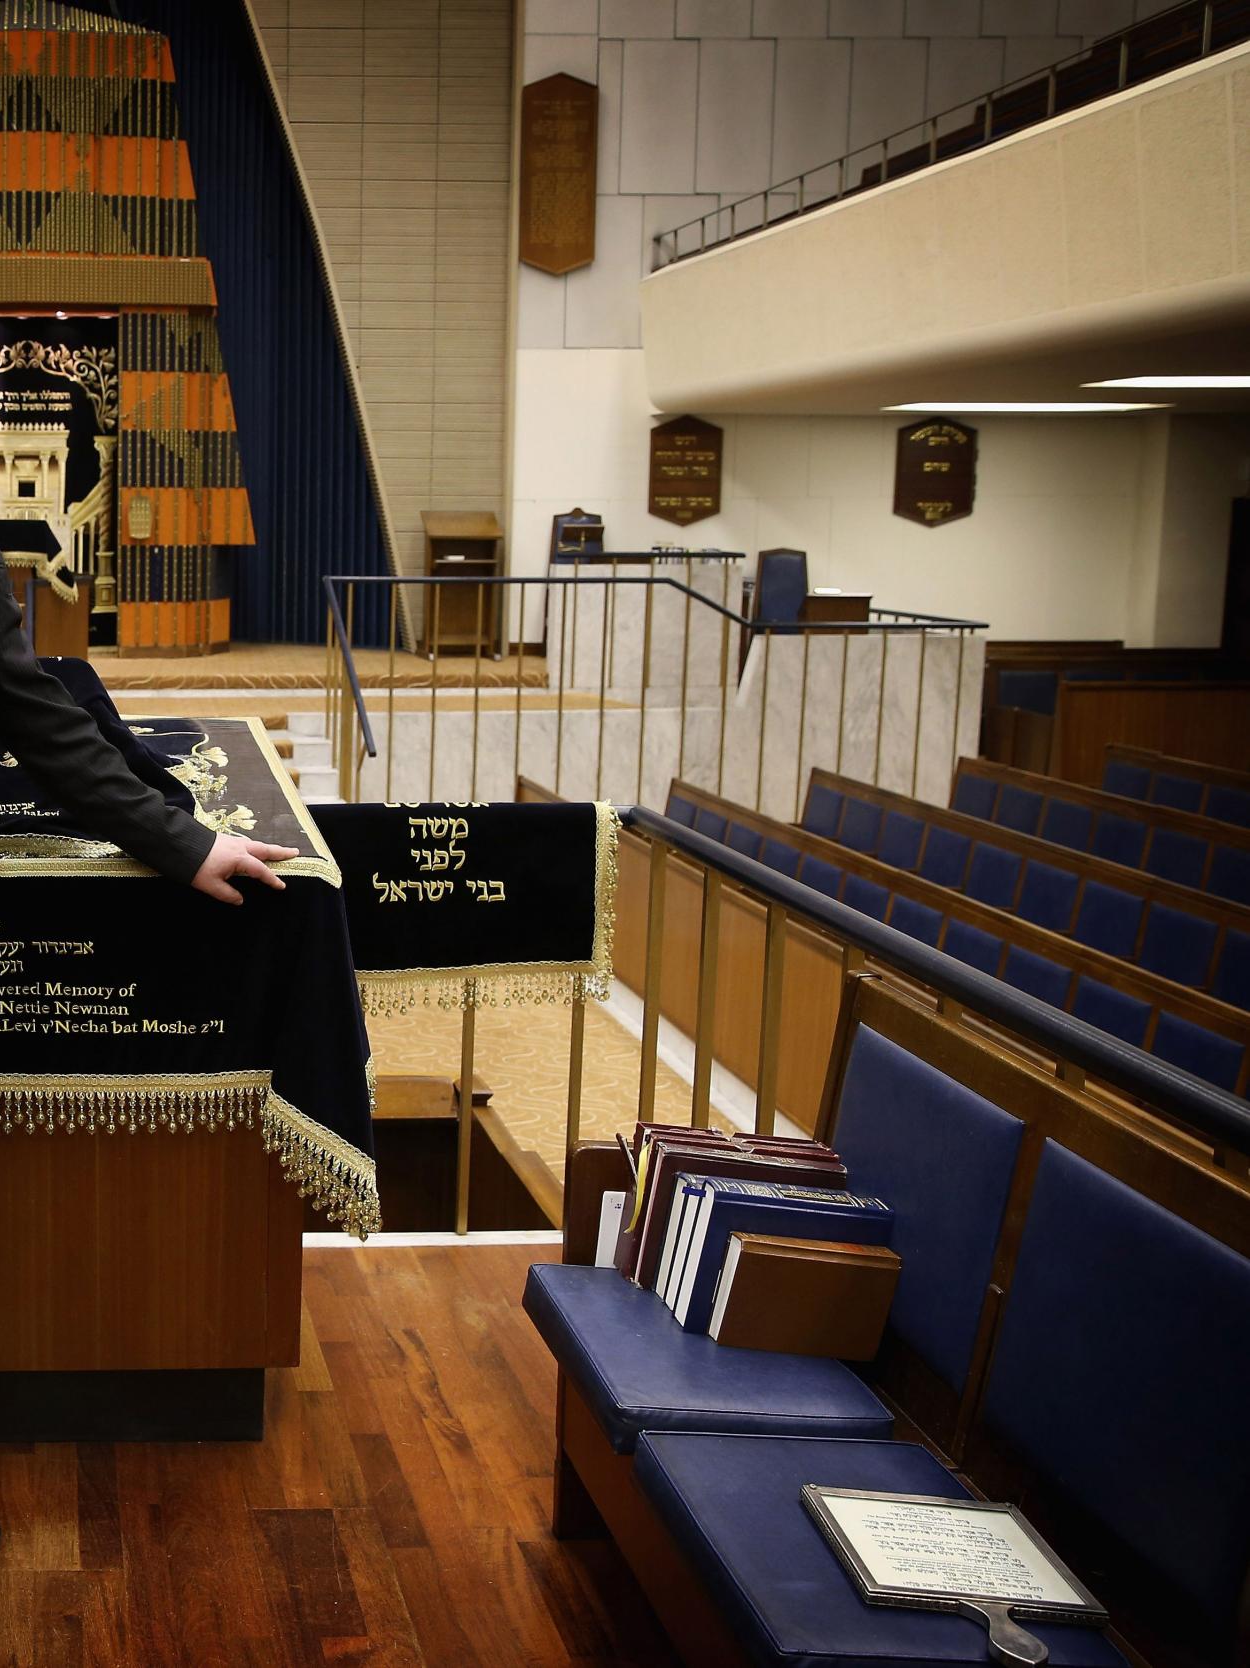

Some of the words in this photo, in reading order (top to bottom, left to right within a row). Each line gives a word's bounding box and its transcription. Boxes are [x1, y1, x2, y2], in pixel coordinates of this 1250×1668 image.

[408, 816, 469, 840] משה
[410, 840, 466, 871] לפני
[372, 872, 454, 904] ישראל
[466, 879, 506, 903] בני
[32, 940, 94, 955] אביגדור
[44, 982, 114, 999] Memory
[118, 983, 137, 997] of
[0, 1000, 50, 1015] Nettie
[54, 1001, 130, 1016] Newman
[40, 1019, 108, 1034] v'Necha
[112, 1020, 139, 1034] bat
[142, 1019, 196, 1035] Moshe
